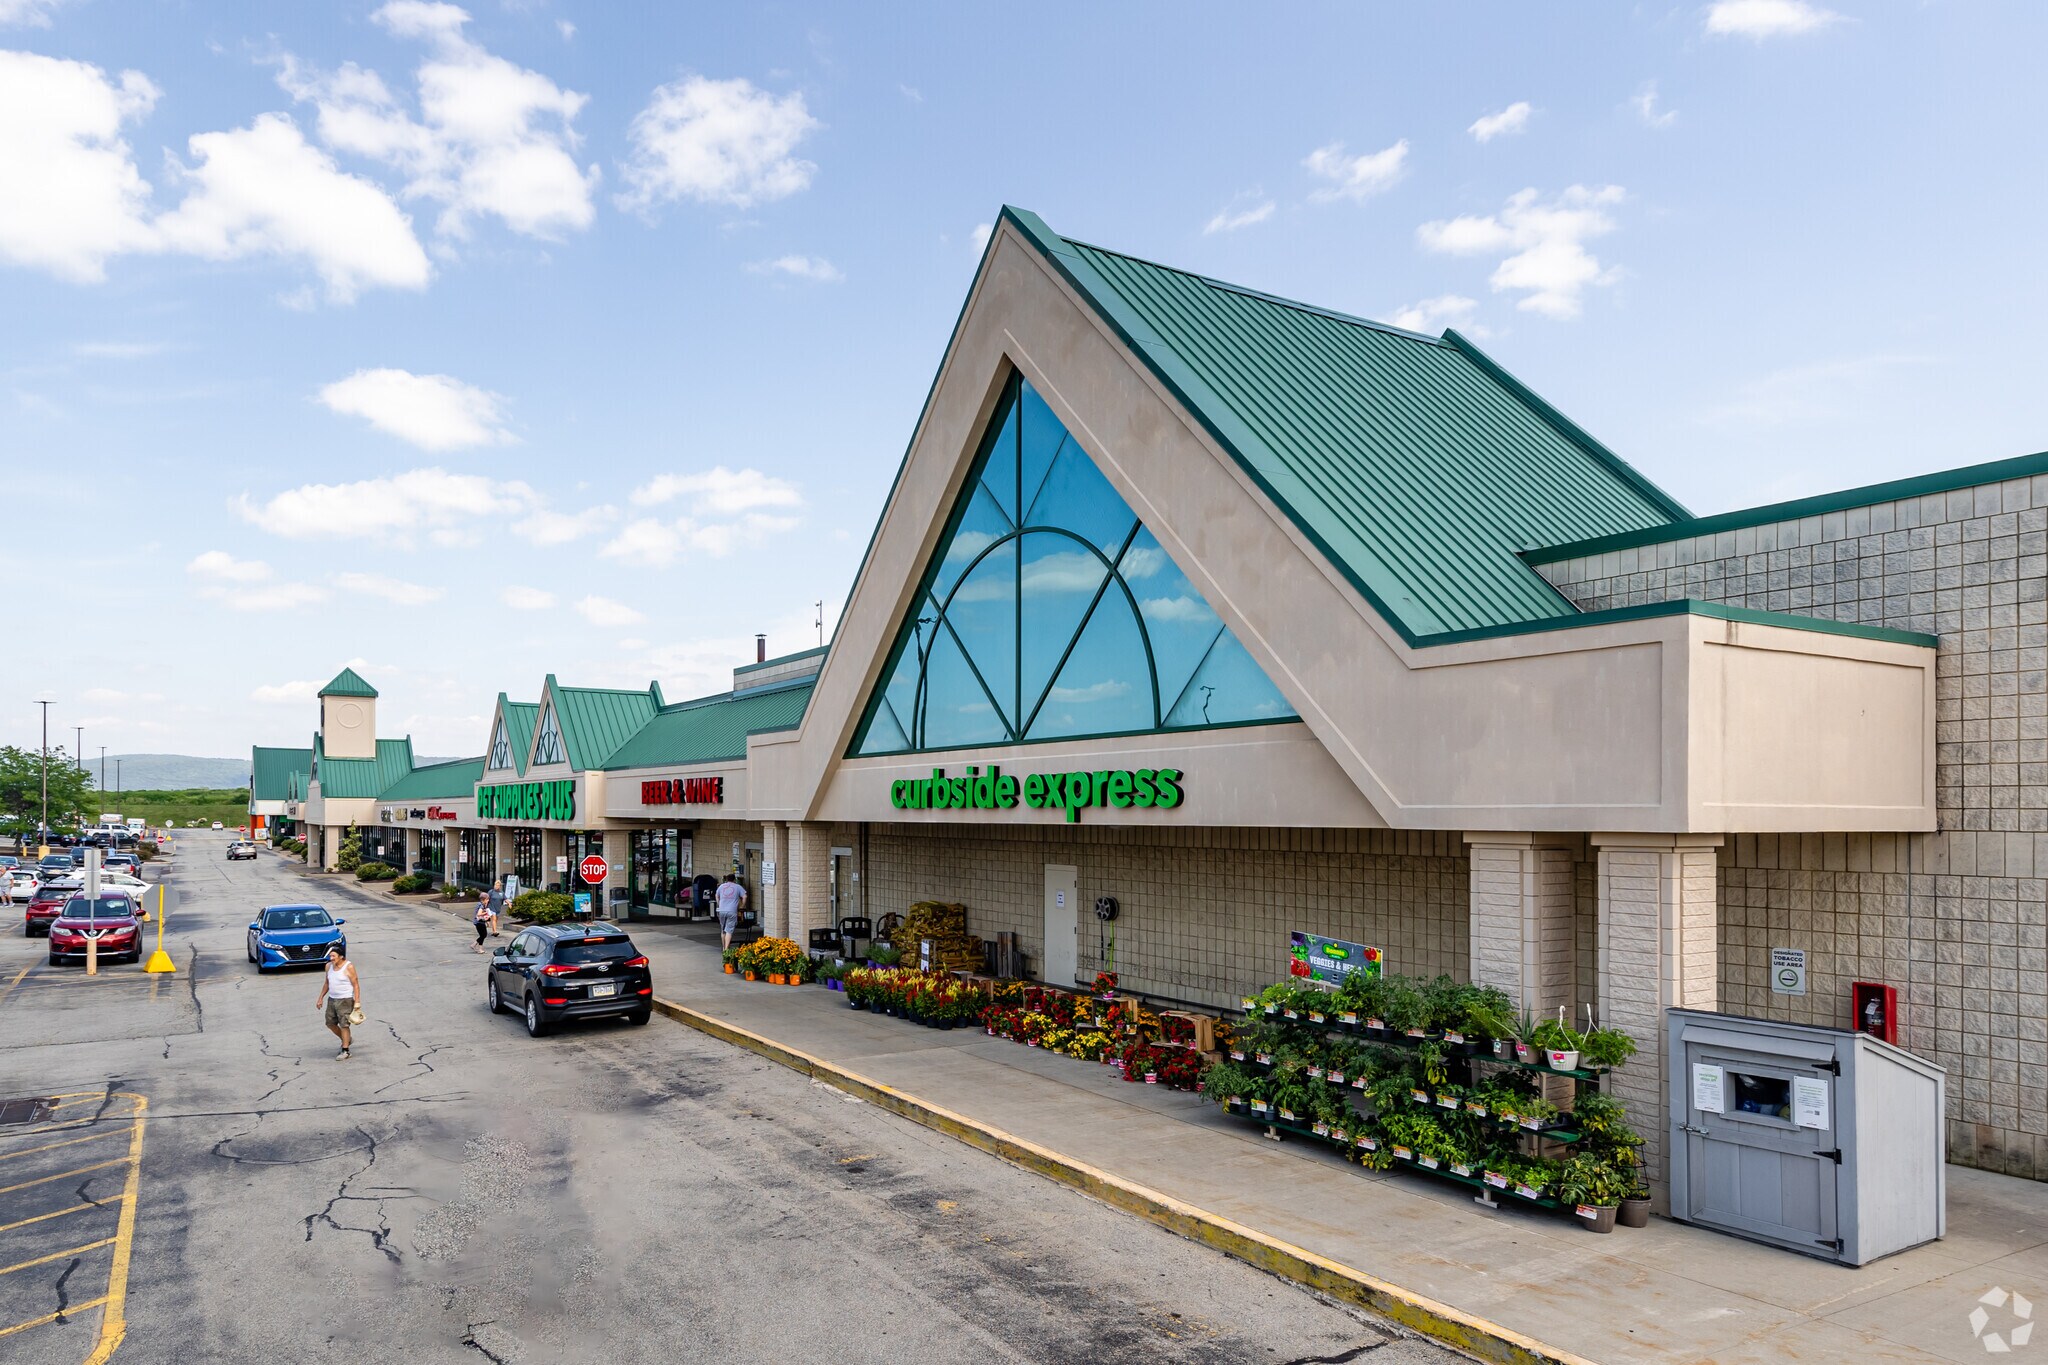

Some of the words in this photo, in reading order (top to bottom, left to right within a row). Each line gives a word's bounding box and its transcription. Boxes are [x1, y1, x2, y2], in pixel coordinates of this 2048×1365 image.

[478, 785, 495, 818] PET
[495, 782, 542, 820] SUPPLIES
[542, 780, 576, 820] PLUS
[642, 780, 672, 804] BEER
[672, 779, 686, 804] &
[684, 777, 723, 804] WINE
[891, 765, 1019, 809] curbside
[1023, 768, 1185, 823] express
[582, 864, 606, 875] STOP
[1310, 956, 1335, 969] VEGGIES
[1335, 961, 1342, 971] &
[1773, 955, 1804, 963] TOBACCO
